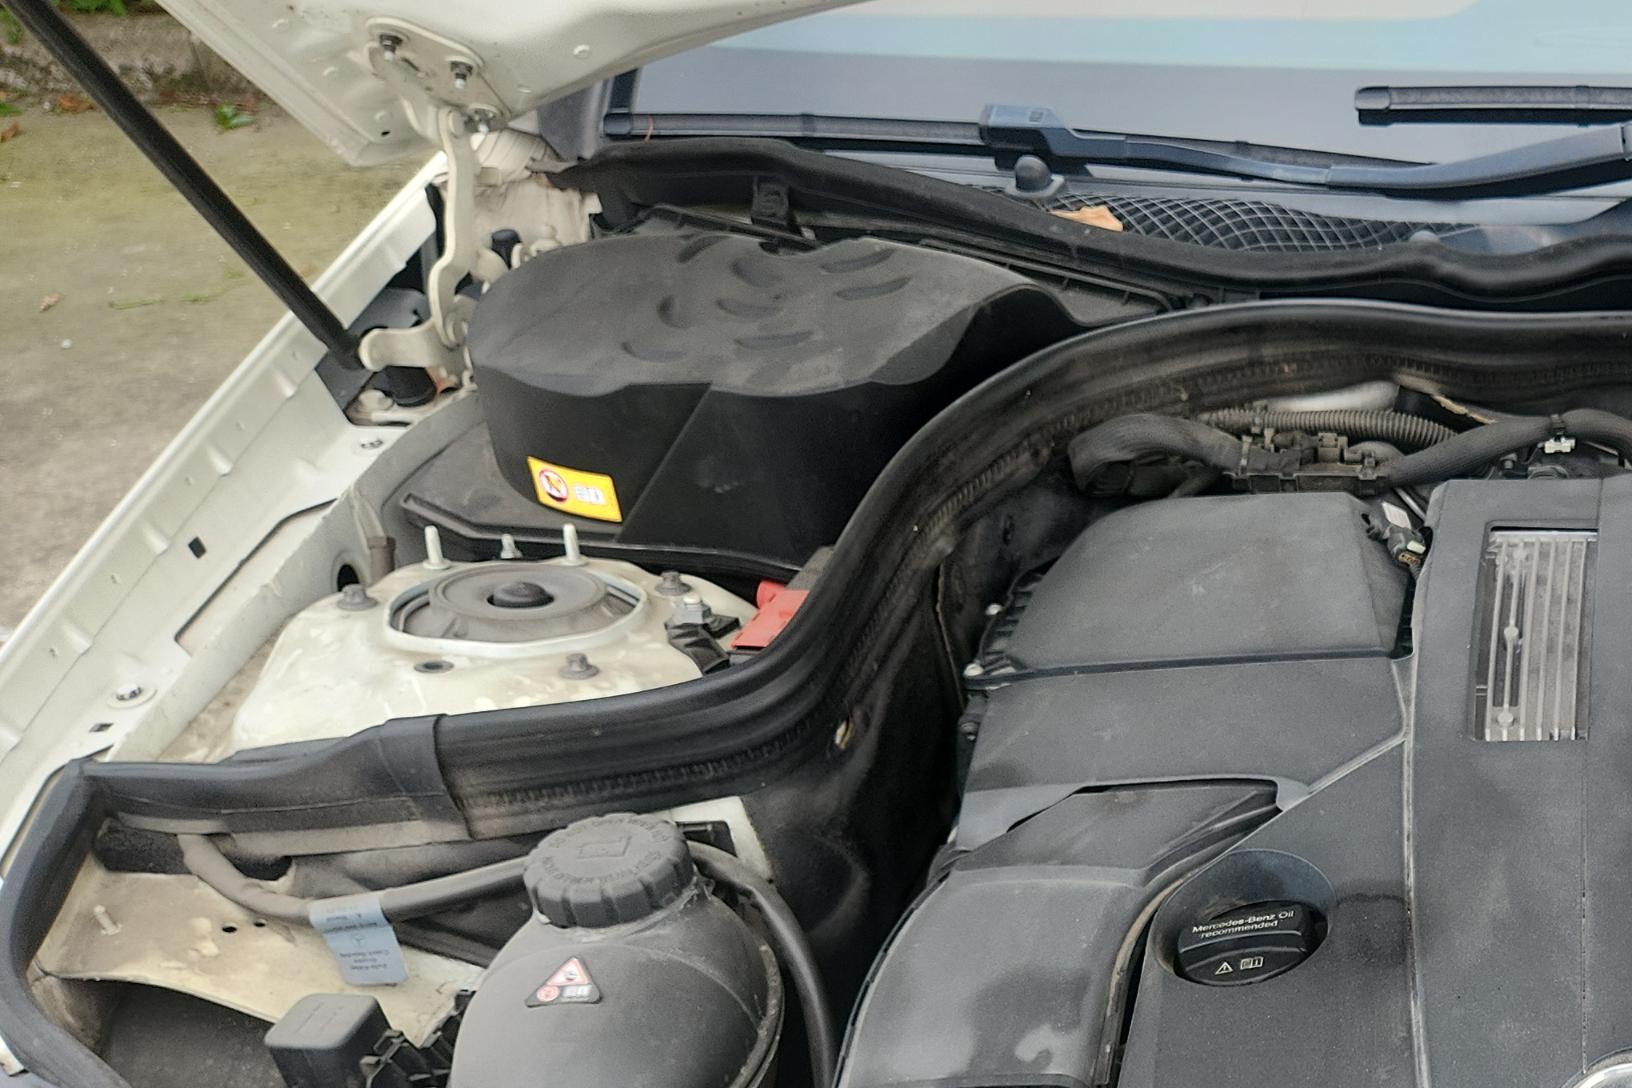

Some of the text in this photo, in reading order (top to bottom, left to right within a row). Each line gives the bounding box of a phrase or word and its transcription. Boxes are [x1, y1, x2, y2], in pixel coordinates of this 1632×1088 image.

[1192, 910, 1295, 933] Mercedes-Benz Oil
[1200, 919, 1279, 938] recommended
